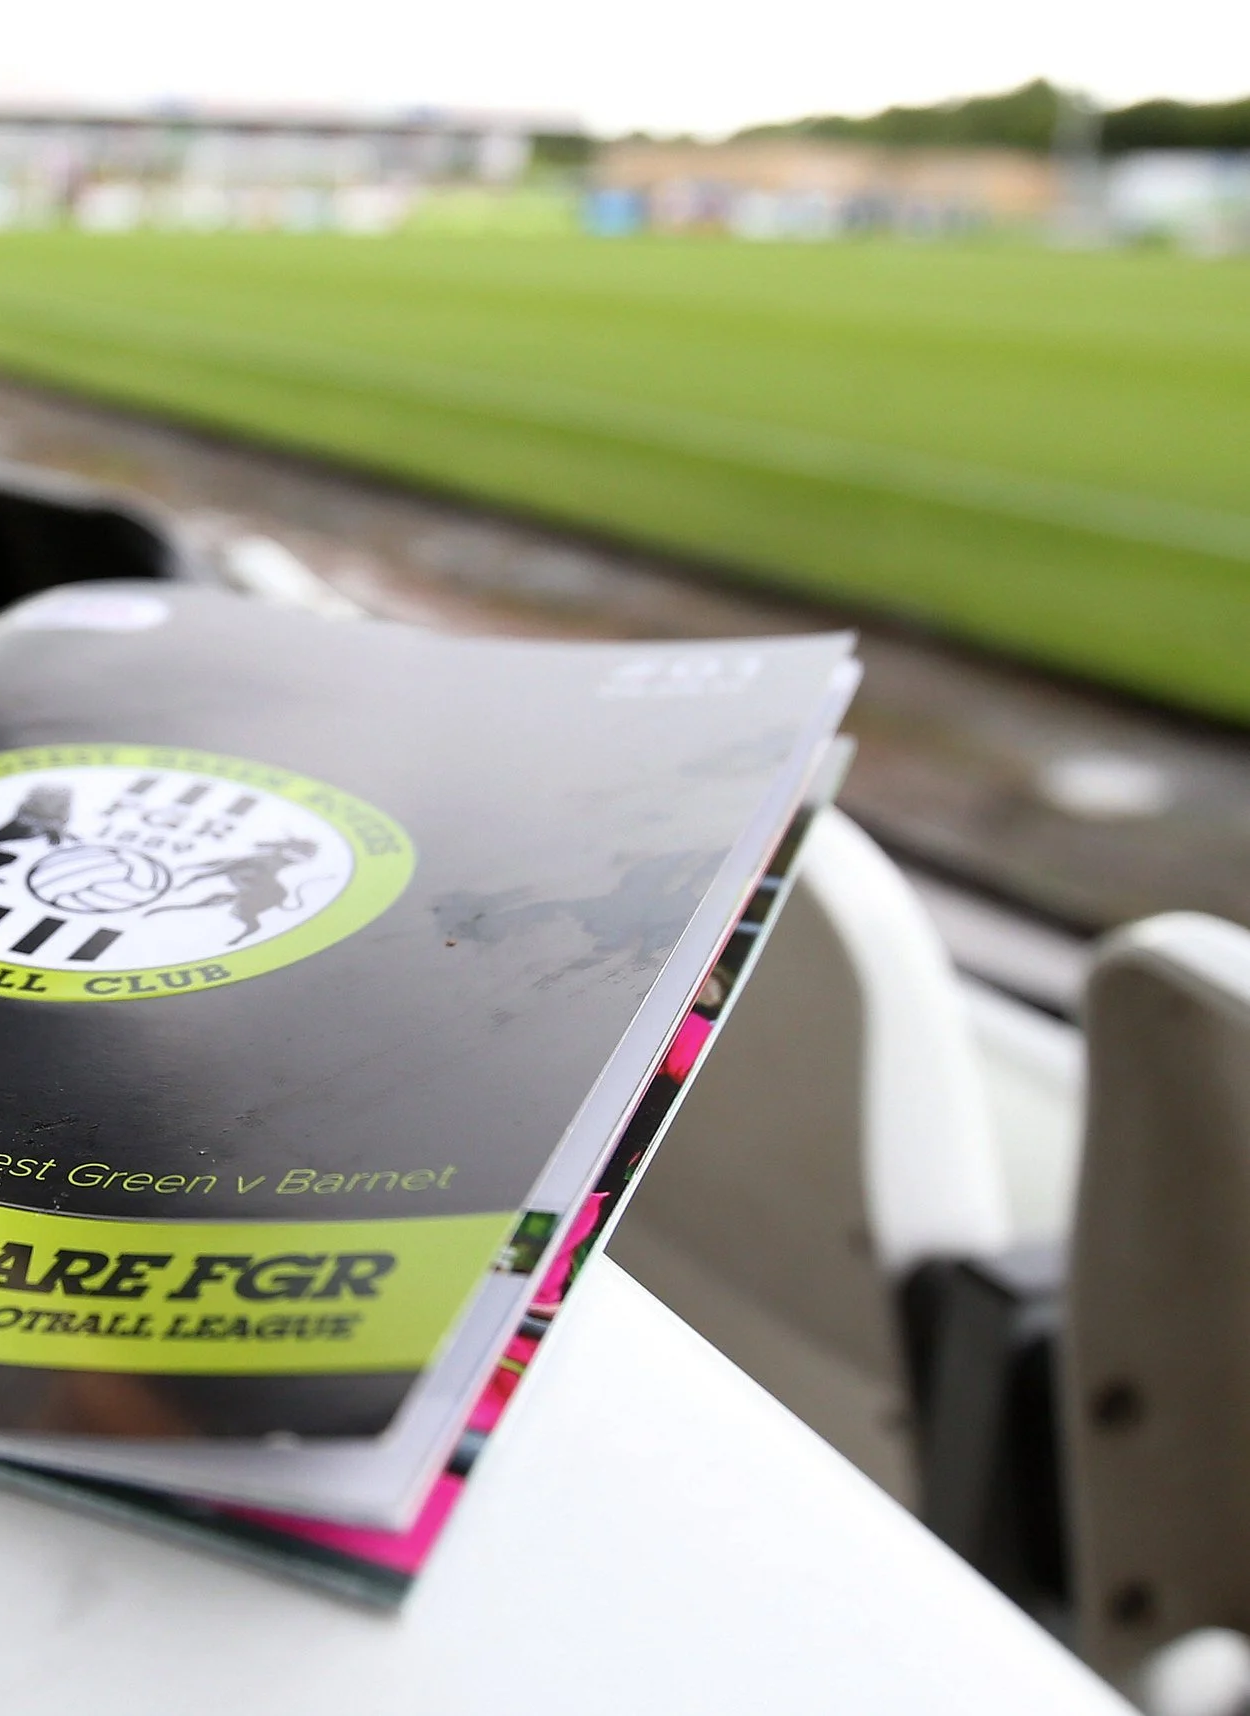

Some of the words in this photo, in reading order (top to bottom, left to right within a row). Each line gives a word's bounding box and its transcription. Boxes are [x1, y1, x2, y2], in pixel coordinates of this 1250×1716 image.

[83, 963, 232, 995] CLUB
[67, 1163, 217, 1195] Green
[238, 1175, 266, 1195] v
[275, 1164, 458, 1195] Barnet
[165, 1253, 396, 1303] FGR
[160, 1310, 364, 1342] LEAGUE
